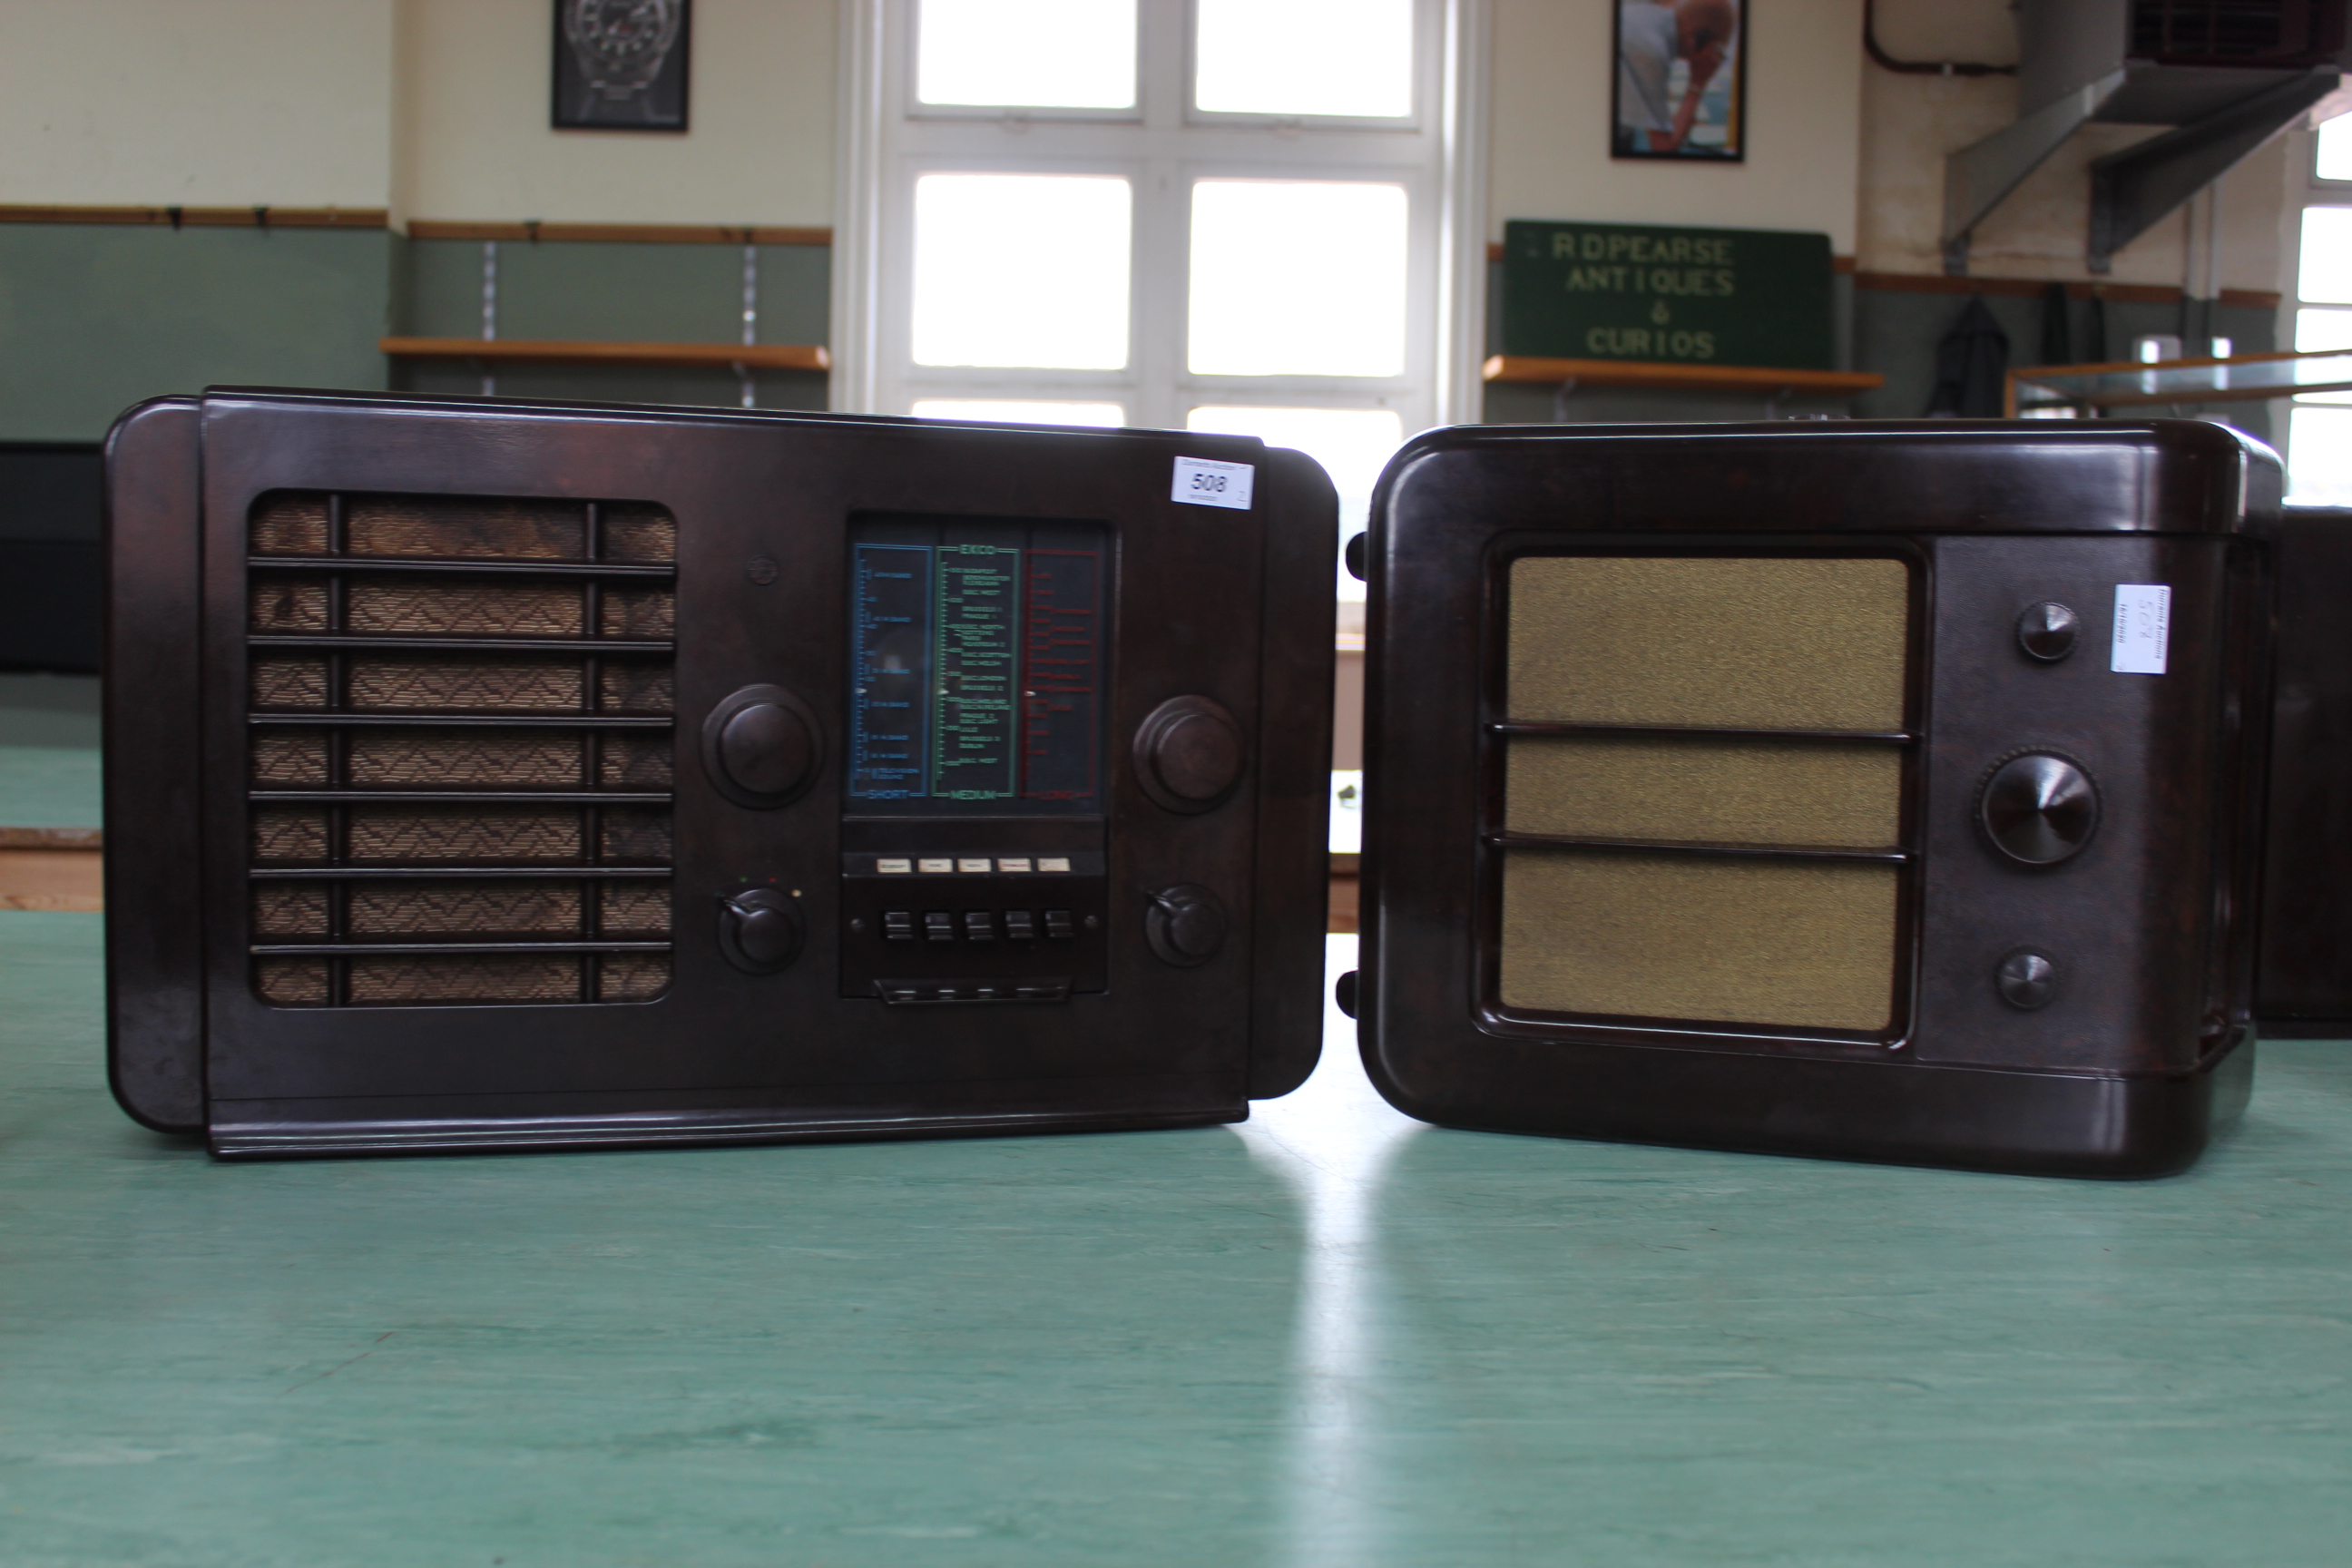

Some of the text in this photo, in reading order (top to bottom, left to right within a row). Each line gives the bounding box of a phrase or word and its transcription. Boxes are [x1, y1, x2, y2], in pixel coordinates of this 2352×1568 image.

[1565, 267, 1734, 296] ANTIQUES
[1650, 299, 1671, 327] &
[1588, 327, 1718, 359] CURIOS
[1191, 473, 1229, 493] 508
[950, 789, 996, 799] MEDIUM
